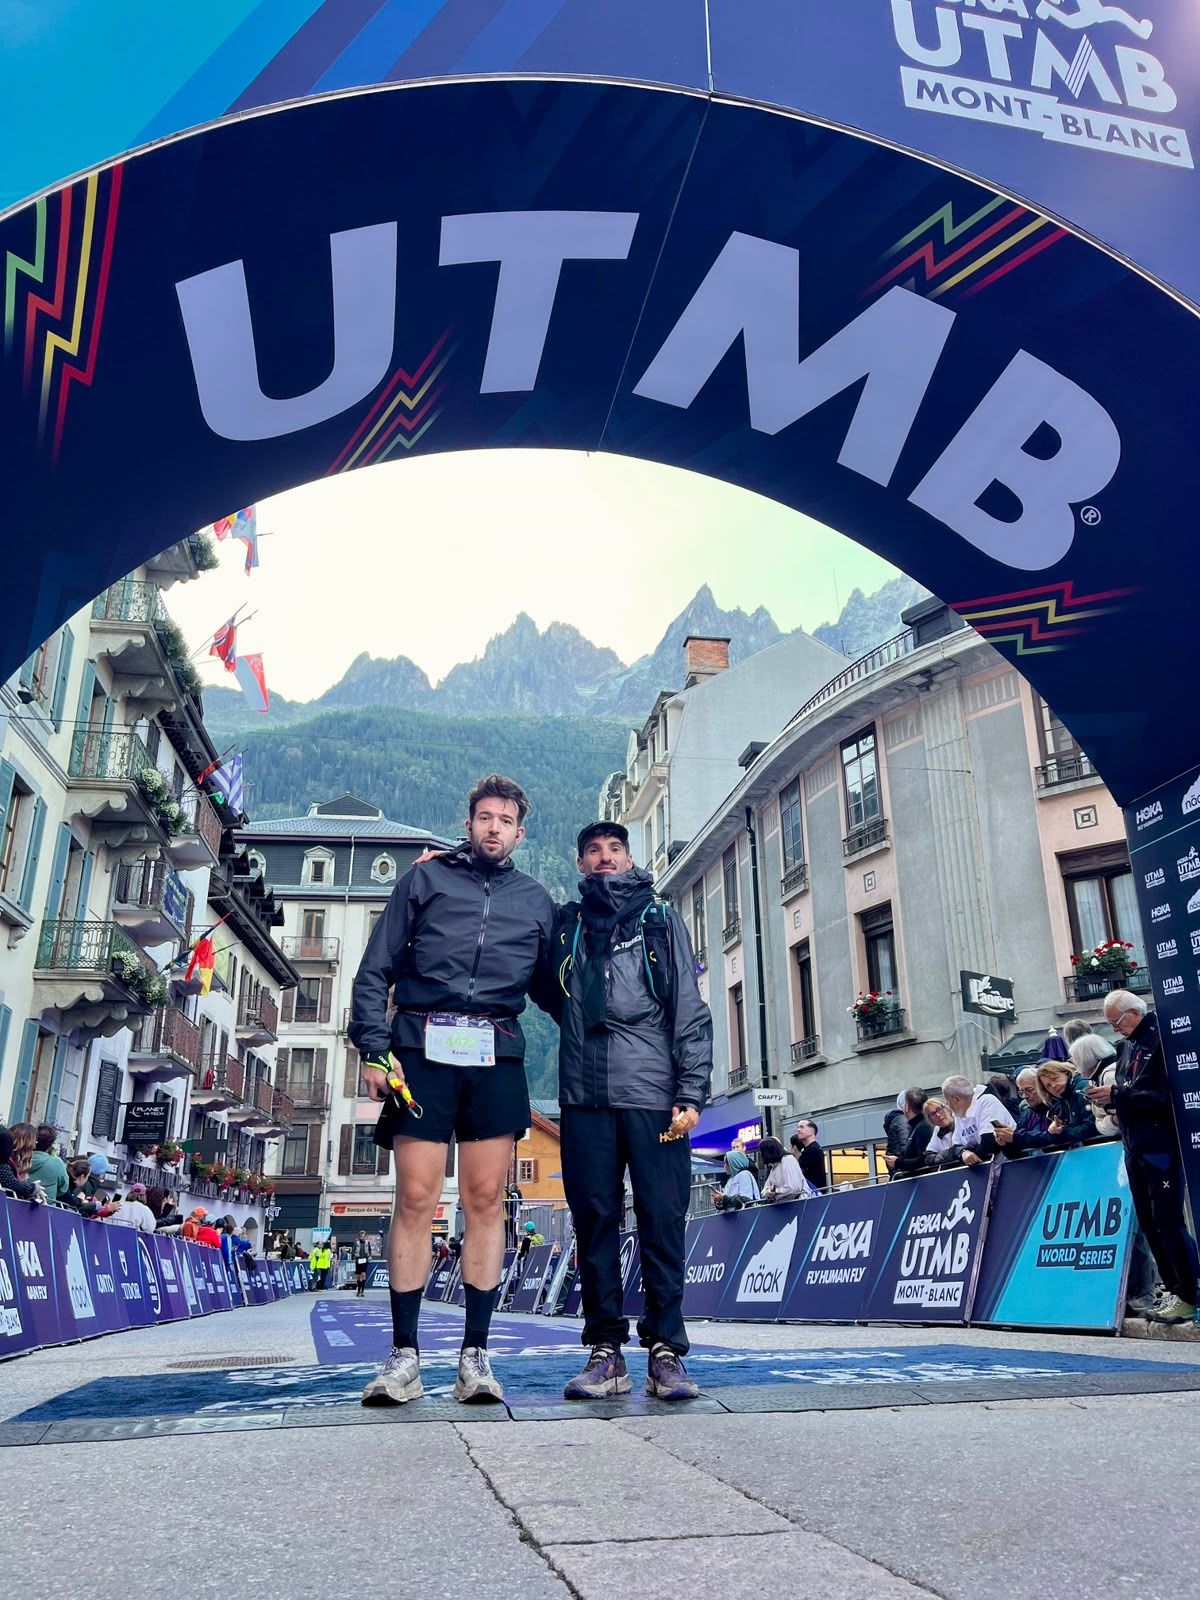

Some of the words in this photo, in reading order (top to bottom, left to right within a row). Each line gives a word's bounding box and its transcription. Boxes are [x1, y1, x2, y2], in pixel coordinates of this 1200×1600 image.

[891, 0, 1177, 113] UTMB
[176, 210, 1121, 571] UTMB
[1136, 800, 1163, 825] HOKA
[1144, 868, 1165, 883] UTMB
[1151, 903, 1171, 918] HOKA
[1156, 939, 1177, 953] UTMB
[1162, 975, 1184, 989] UTMB
[1170, 1015, 1191, 1029] HOKA
[1176, 1052, 1198, 1065] UTMB
[1182, 1091, 1200, 1103] UTM
[907, 1213, 942, 1236] HOKA
[1042, 1196, 1122, 1240] UTMB
[811, 1219, 874, 1262] HOKA
[900, 1232, 970, 1277] UTMB
[1040, 1247, 1077, 1263] WORLD
[1079, 1249, 1114, 1266] SERIES
[685, 1262, 725, 1284] SUUNTO
